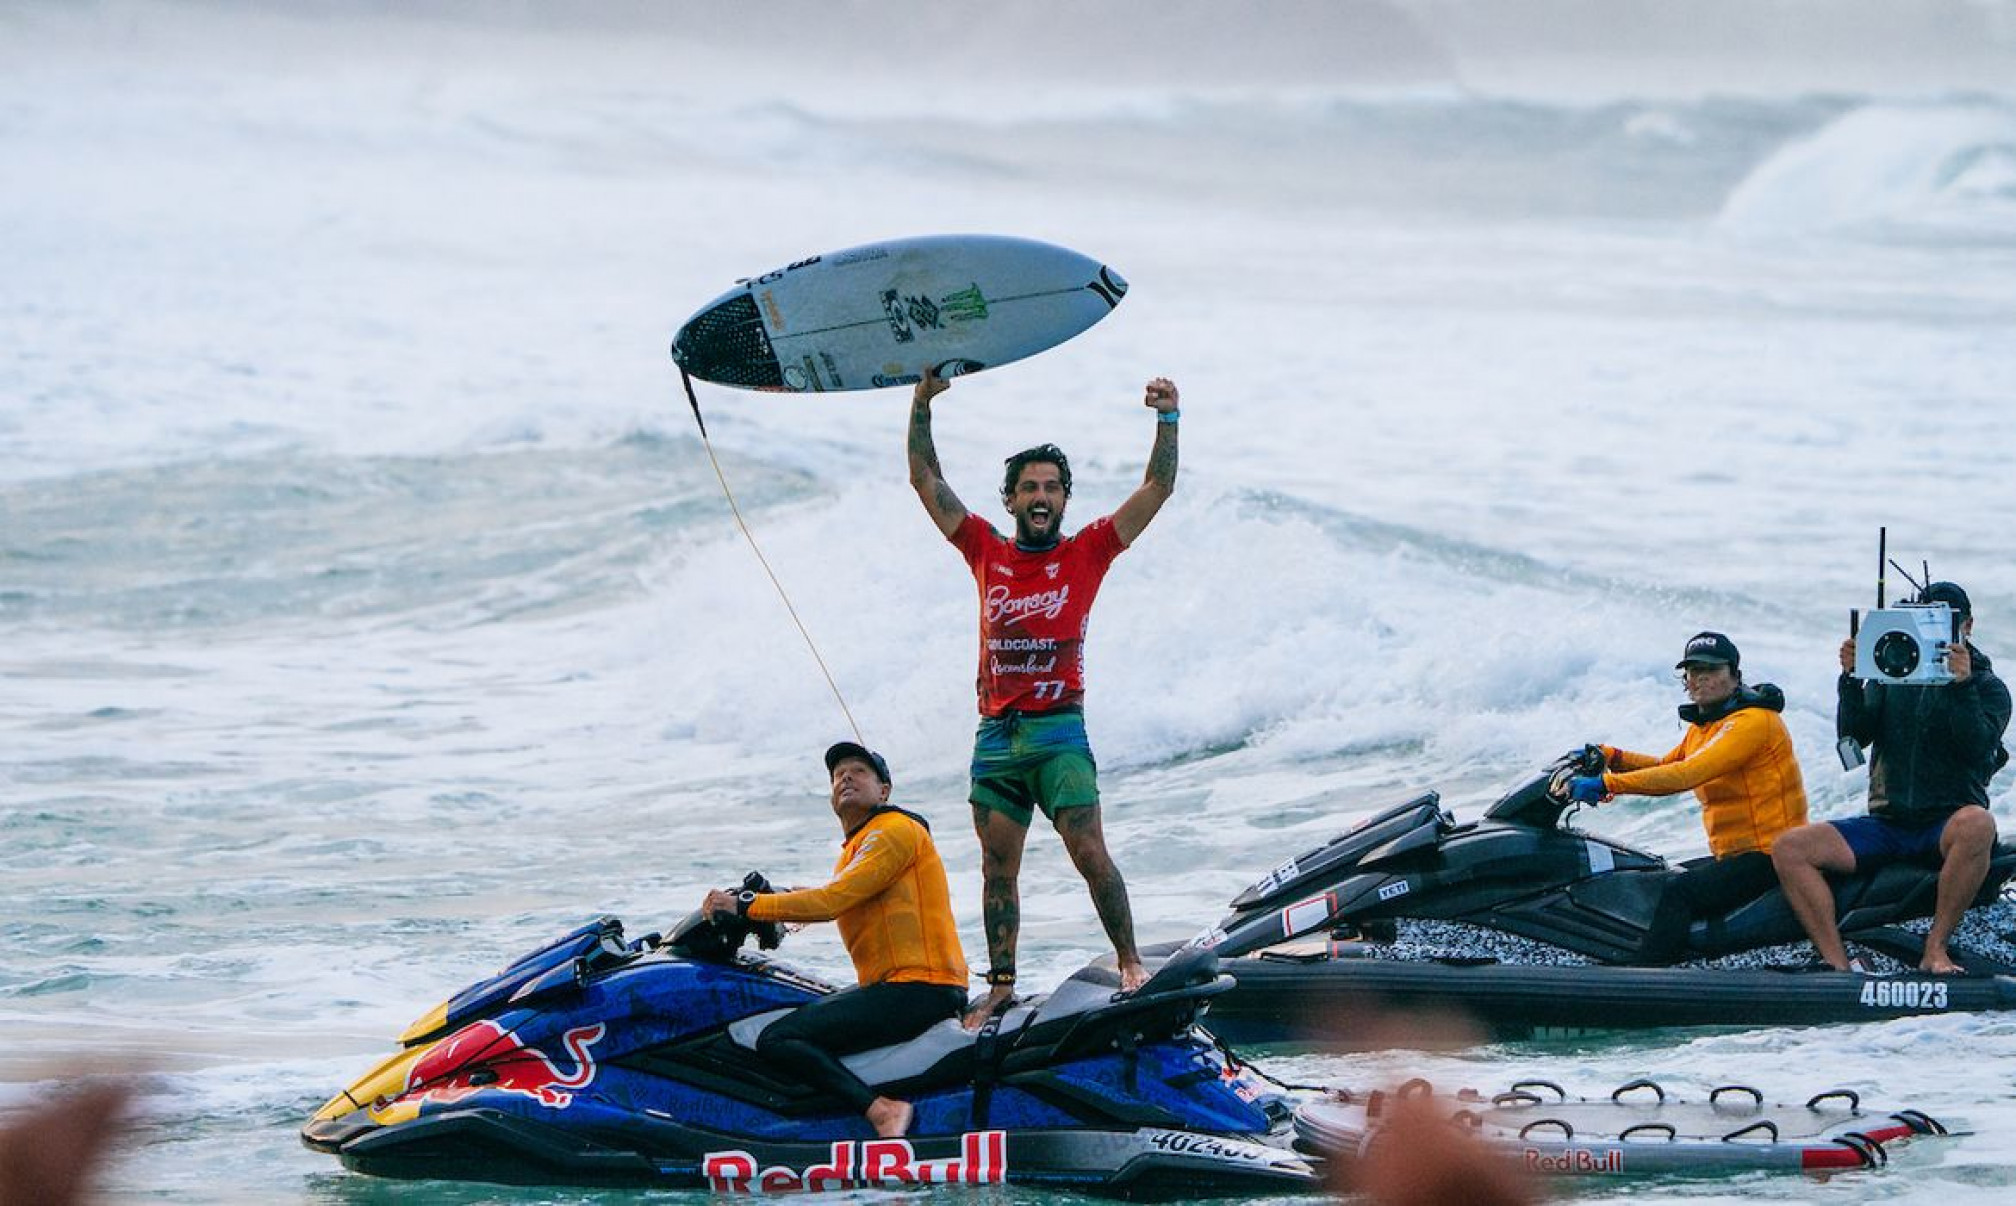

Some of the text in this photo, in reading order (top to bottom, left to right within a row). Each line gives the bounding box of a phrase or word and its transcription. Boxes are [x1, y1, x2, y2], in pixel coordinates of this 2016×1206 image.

[984, 584, 1069, 624] Bonsoy
[1033, 681, 1066, 700] 77
[1860, 981, 1948, 1008] 460023
[1525, 1148, 1622, 1173] Red Bull
